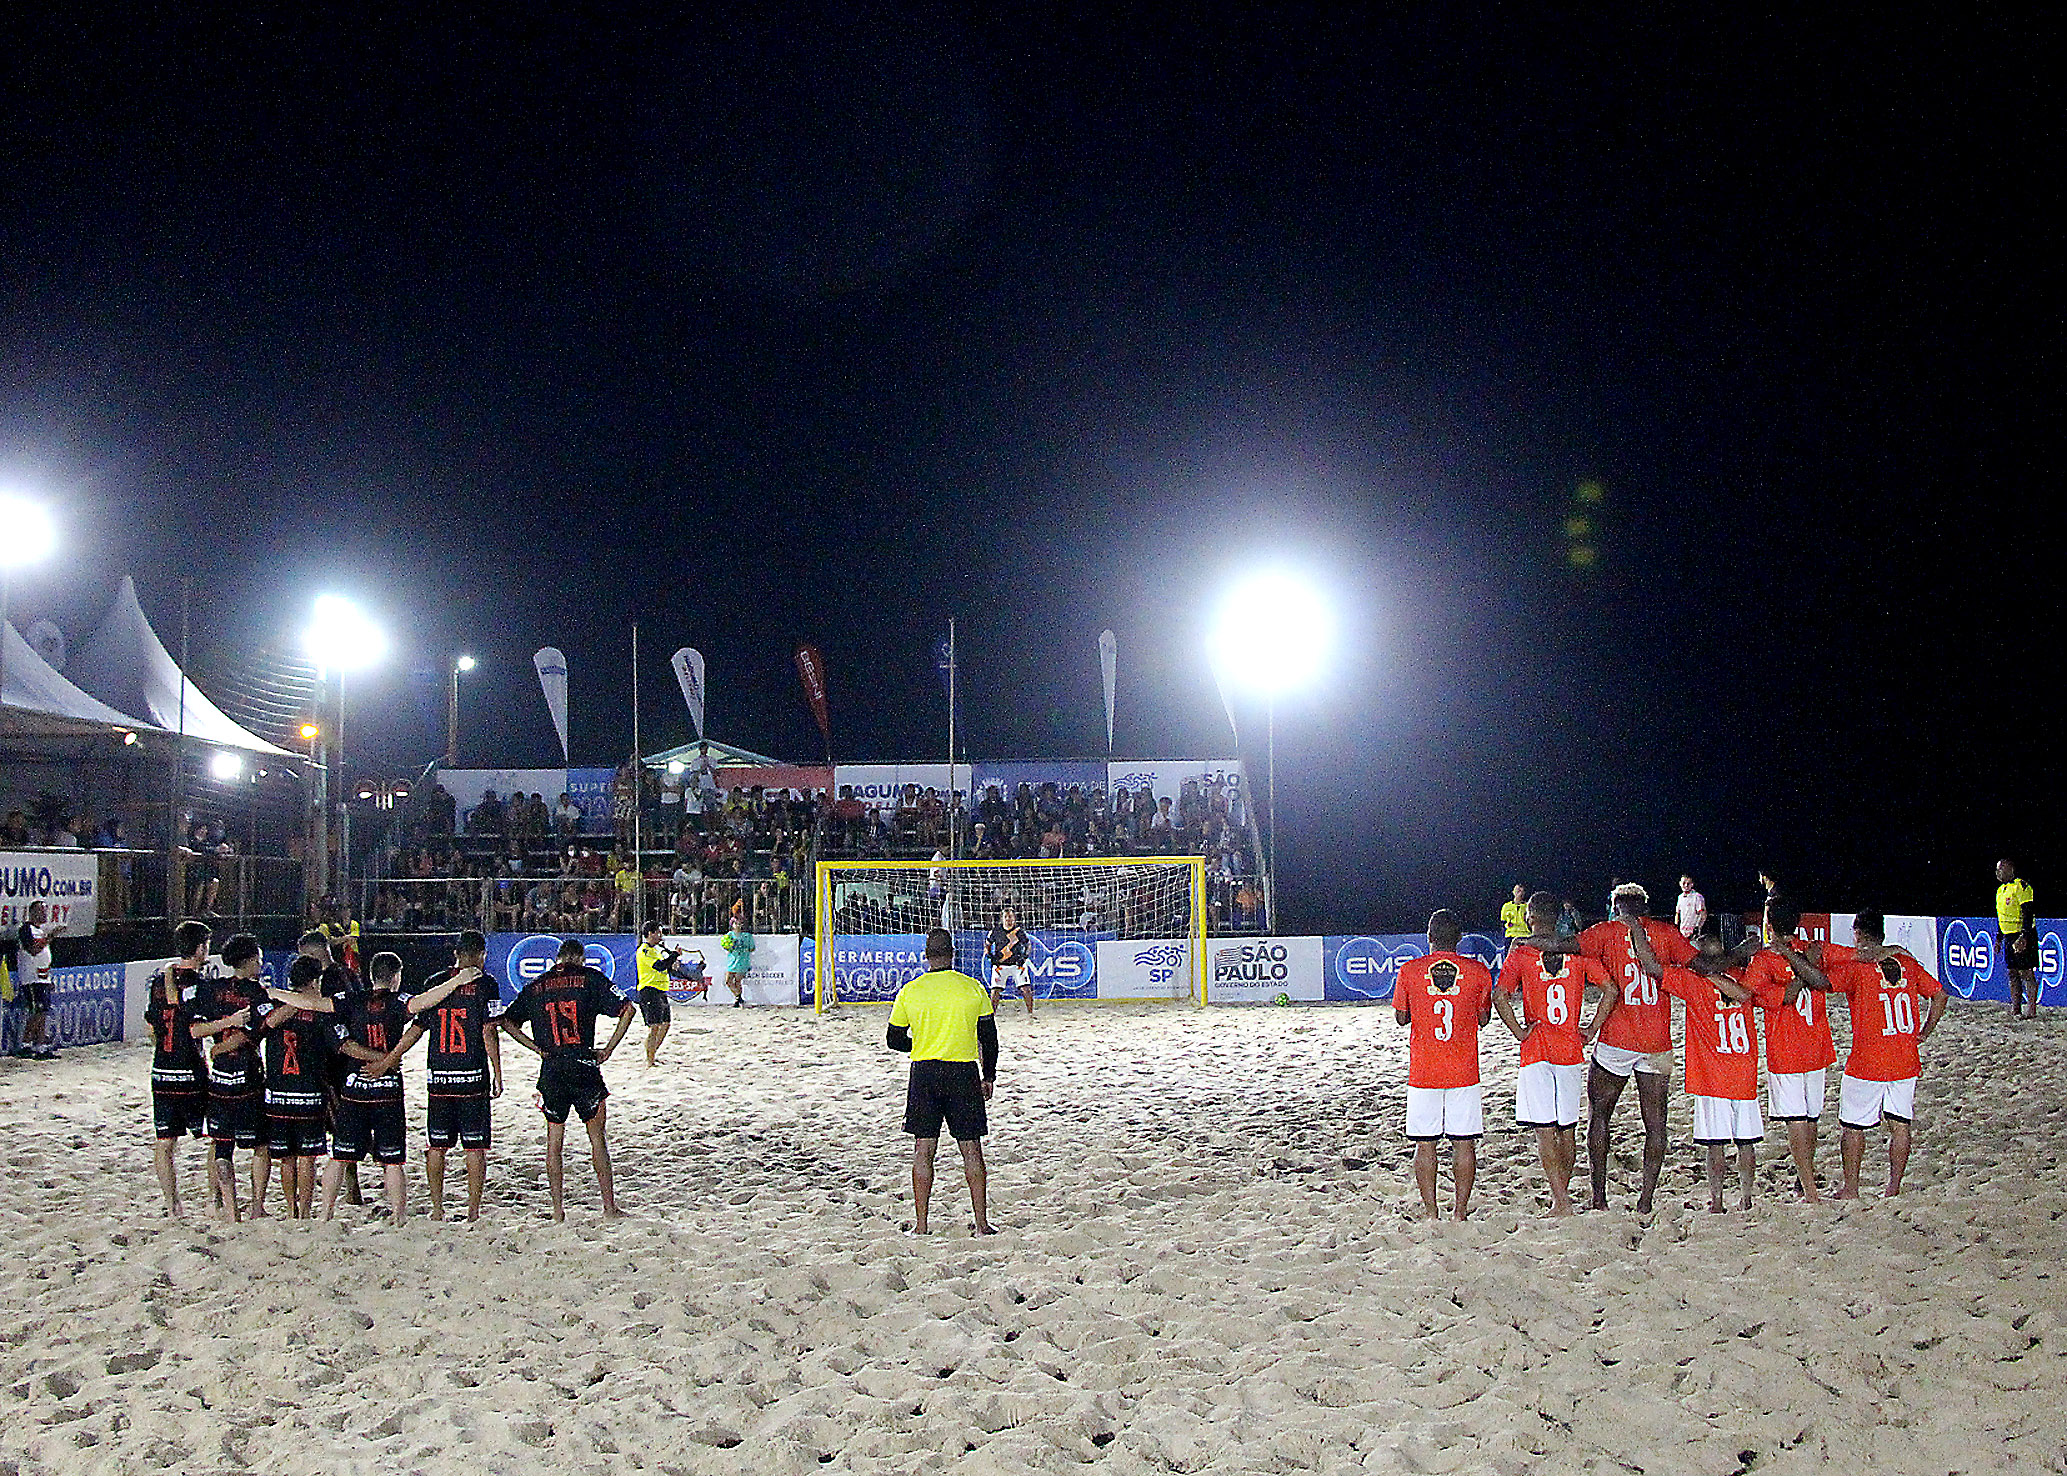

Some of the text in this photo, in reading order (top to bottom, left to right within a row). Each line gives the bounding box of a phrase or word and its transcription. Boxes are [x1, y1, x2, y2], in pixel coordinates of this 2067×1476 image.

[1026, 956, 1081, 977] MS
[1215, 963, 1288, 981] PAULO
[1241, 941, 1288, 962] SÃO
[1949, 944, 1988, 969] EMS
[1149, 969, 1174, 982] SP
[1624, 962, 1659, 1006] 20
[545, 1000, 582, 1046] 19
[1433, 998, 1454, 1042] 3
[1546, 983, 1568, 1026] 8
[1878, 992, 1915, 1037] 10
[437, 1008, 467, 1053] 16
[1714, 1012, 1750, 1055] 18
